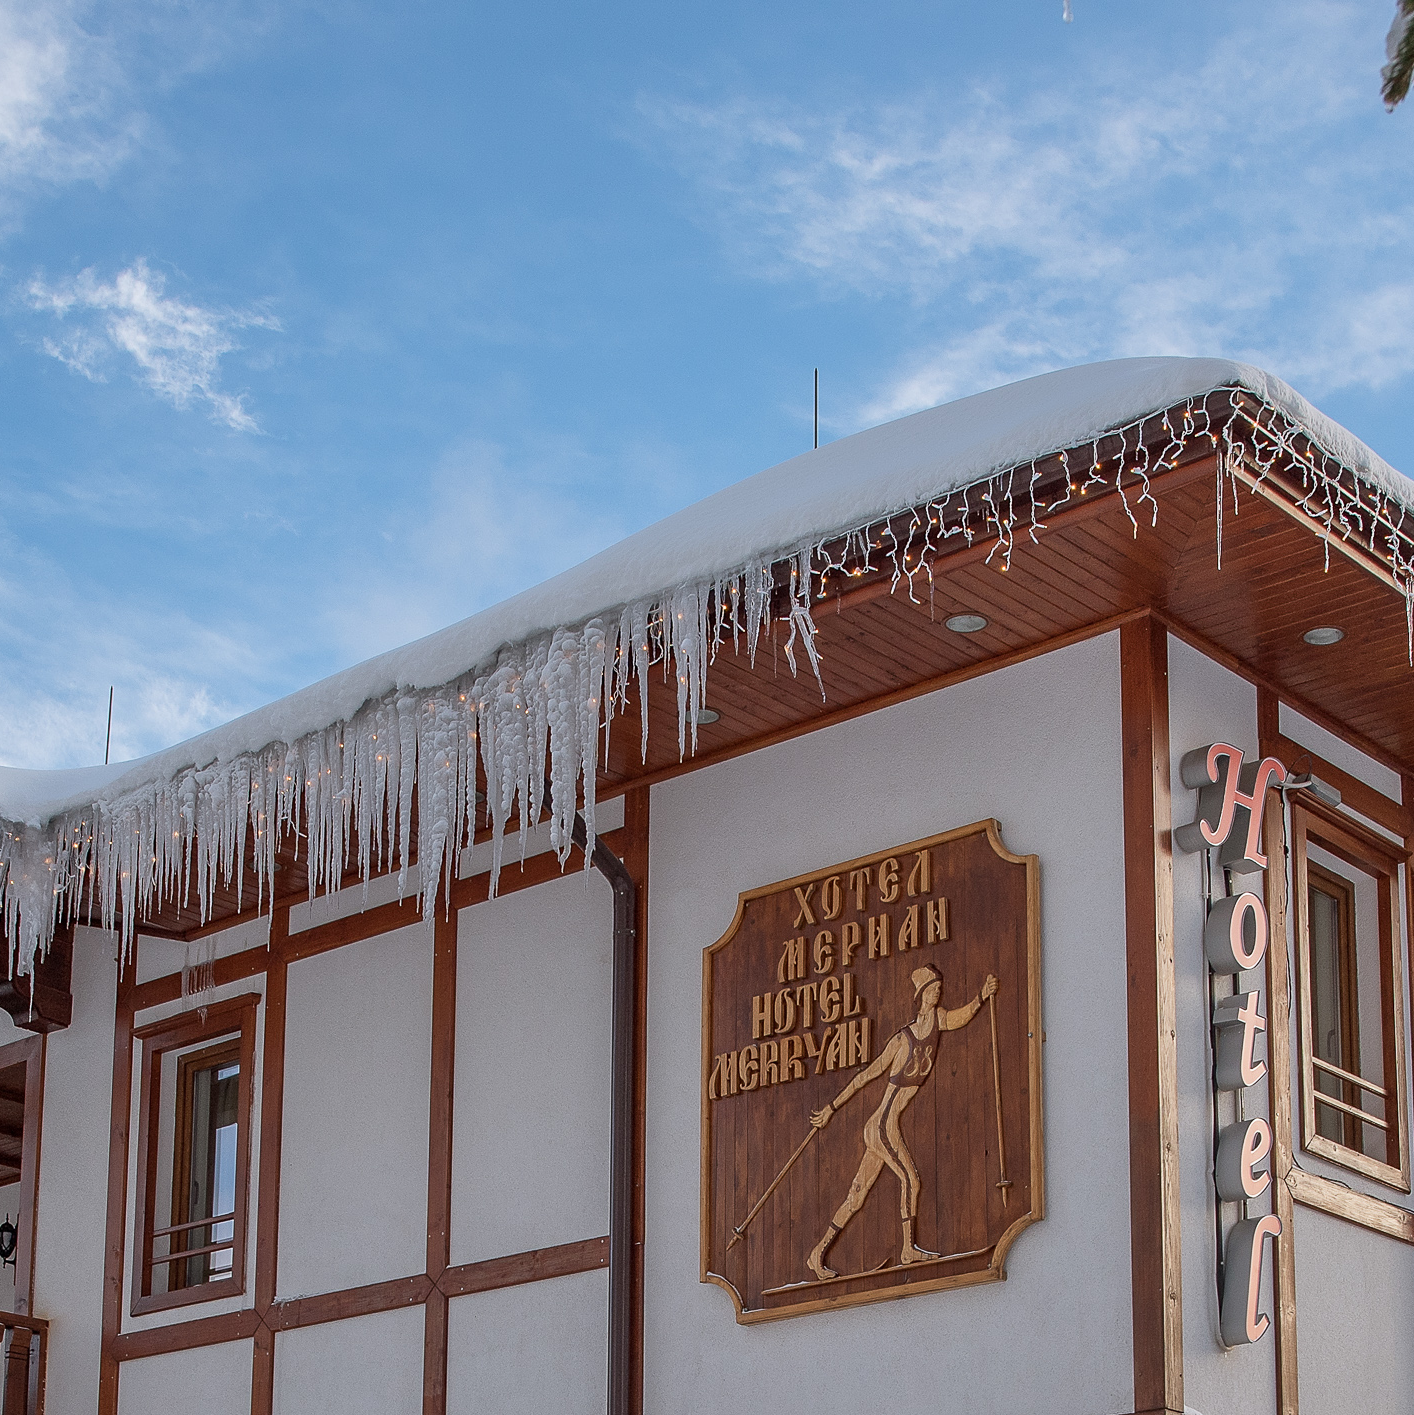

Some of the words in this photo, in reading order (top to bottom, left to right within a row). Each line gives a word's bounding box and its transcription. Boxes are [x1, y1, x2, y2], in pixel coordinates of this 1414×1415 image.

[793, 849, 932, 929] ХОТЕЛ
[752, 972, 863, 1039] HOTEL
[1195, 742, 1286, 1343] Hotel
[708, 1017, 872, 1100] MERRYAN
